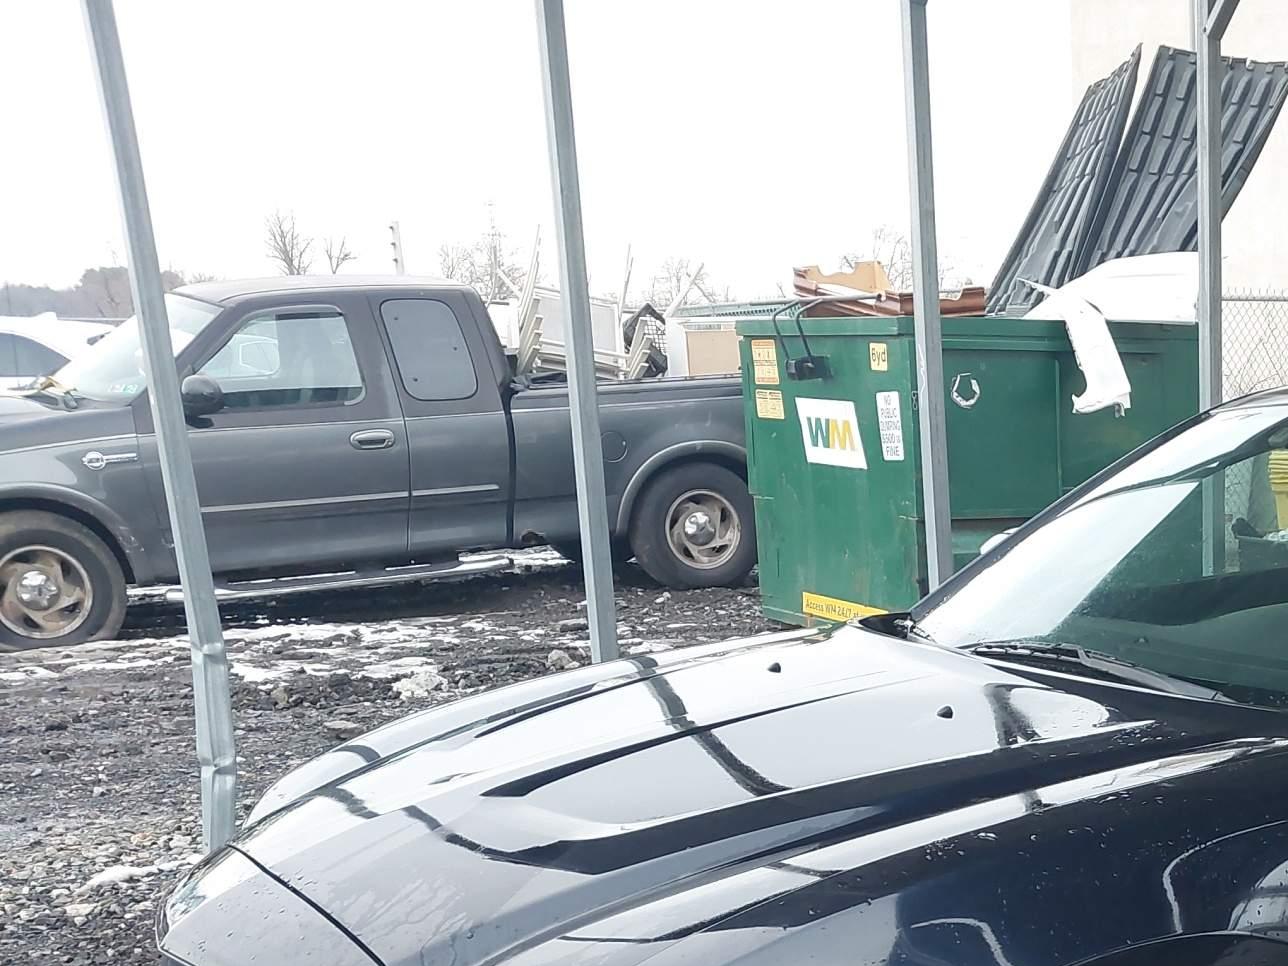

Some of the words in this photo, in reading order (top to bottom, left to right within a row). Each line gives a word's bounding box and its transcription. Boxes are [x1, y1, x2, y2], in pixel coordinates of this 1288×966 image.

[872, 347, 887, 366] 6yd
[806, 416, 857, 451] WM
[886, 446, 900, 457] FINE
